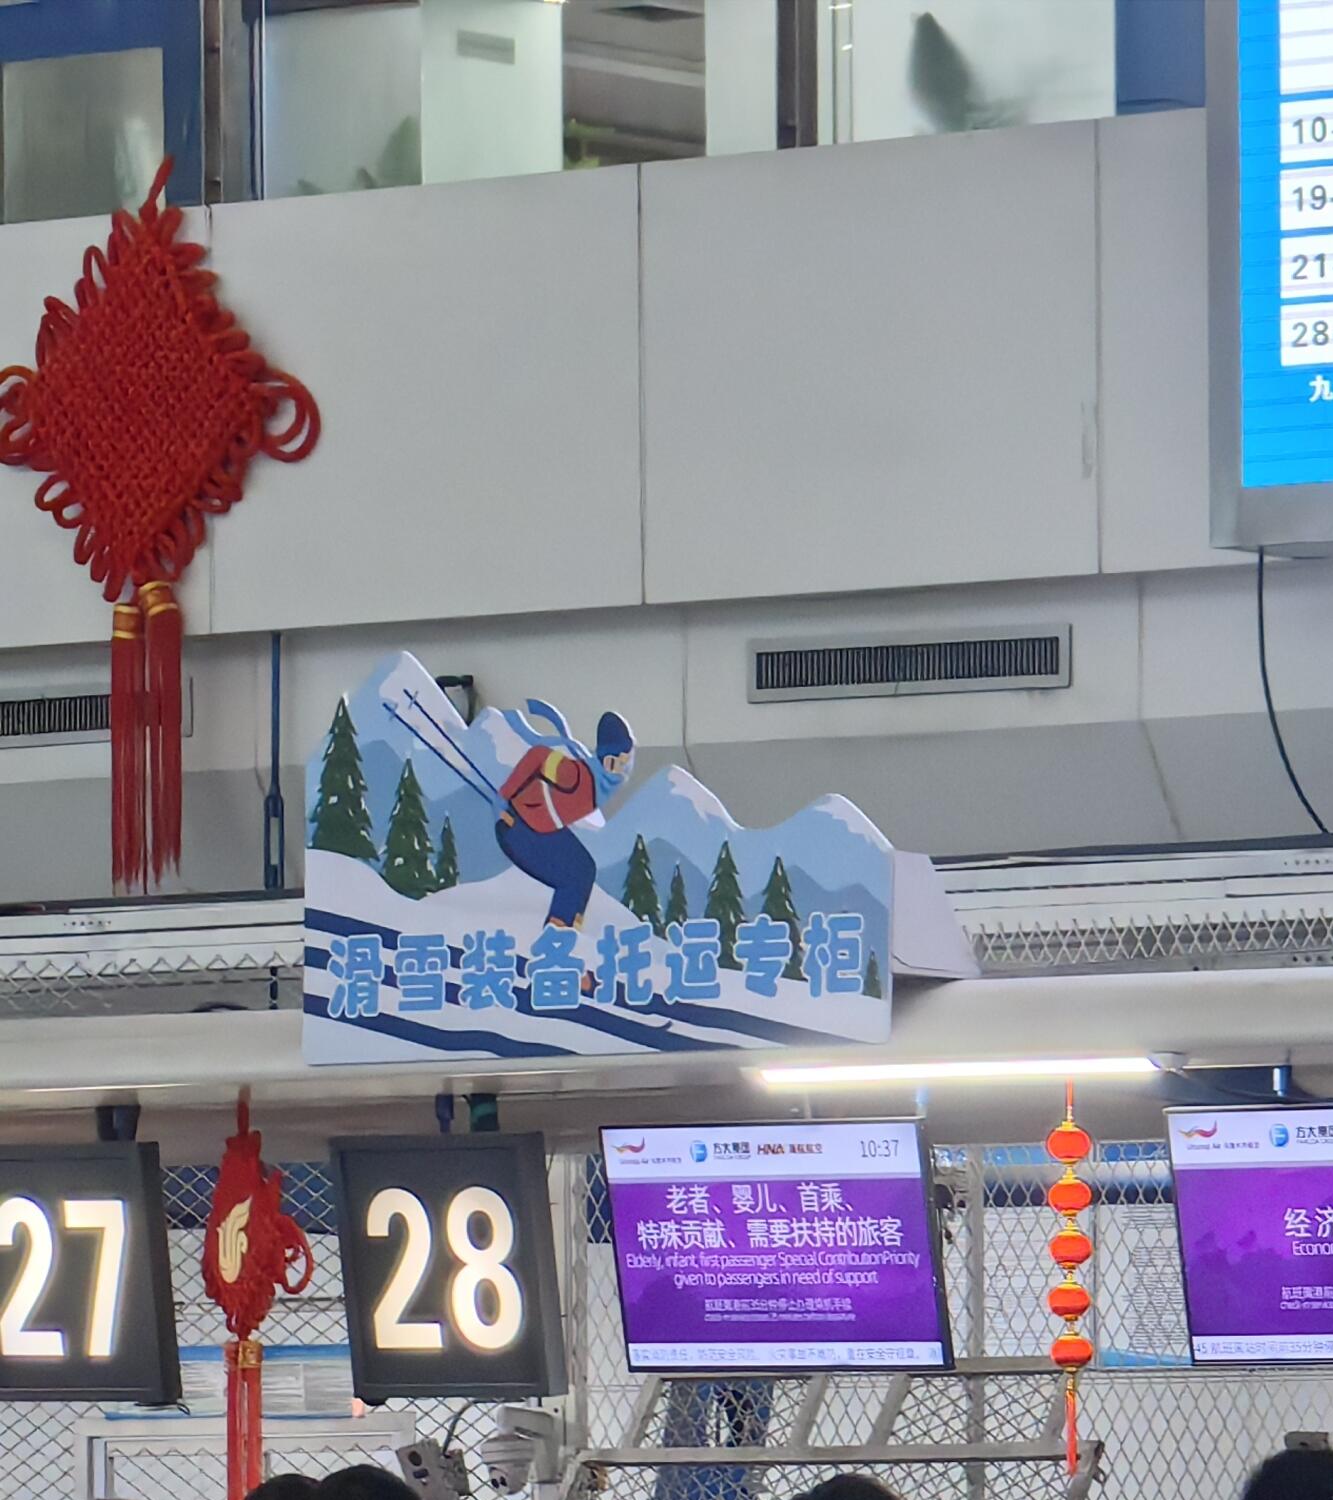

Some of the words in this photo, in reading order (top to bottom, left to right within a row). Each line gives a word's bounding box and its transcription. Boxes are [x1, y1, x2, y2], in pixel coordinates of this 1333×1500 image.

[326, 911, 868, 1020] 滑雪装备托运专柜
[860, 1139, 900, 1158] 10:37
[0, 1197, 126, 1357] 27
[367, 1186, 523, 1352] 28
[636, 1216, 904, 1250] 特殊贡献、需要扶持的旅客
